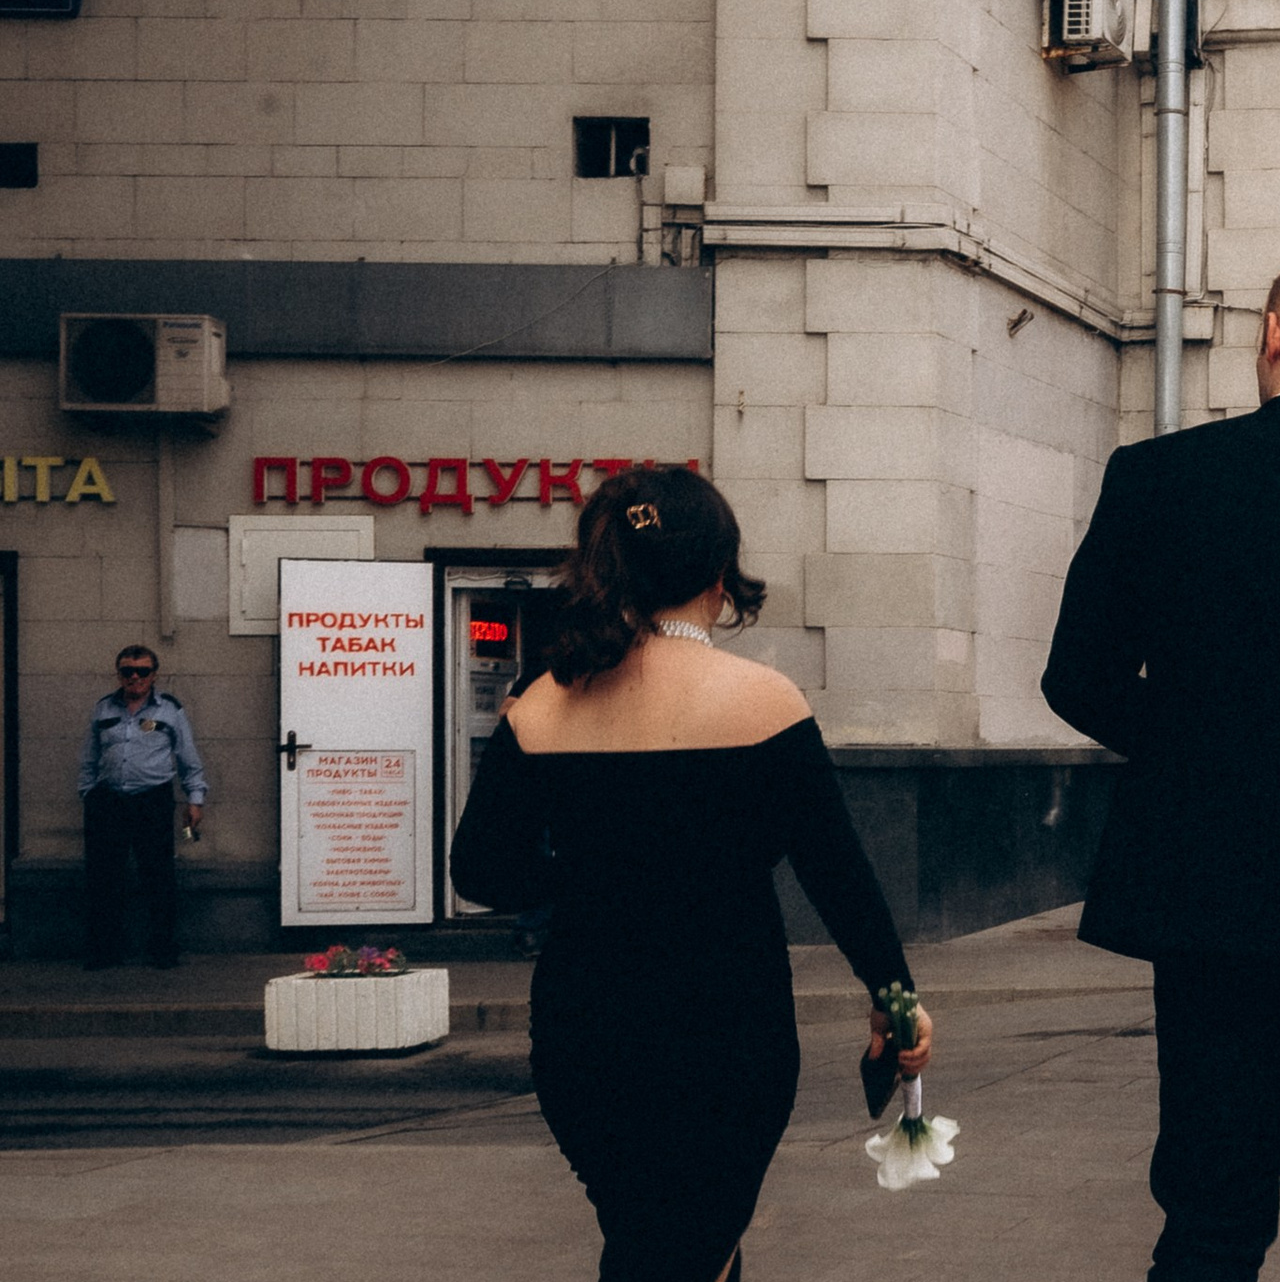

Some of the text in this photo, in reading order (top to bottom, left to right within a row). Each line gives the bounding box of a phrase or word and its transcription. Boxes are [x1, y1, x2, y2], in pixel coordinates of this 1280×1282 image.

[287, 612, 425, 630] ПРОДУКТЫ
[316, 637, 396, 652] ТАБАК
[298, 661, 415, 677] НАПИТКИ
[318, 756, 378, 765] МАГАЗИН
[384, 758, 401, 768] 24
[306, 769, 377, 778] ПРОДУКТЫ
